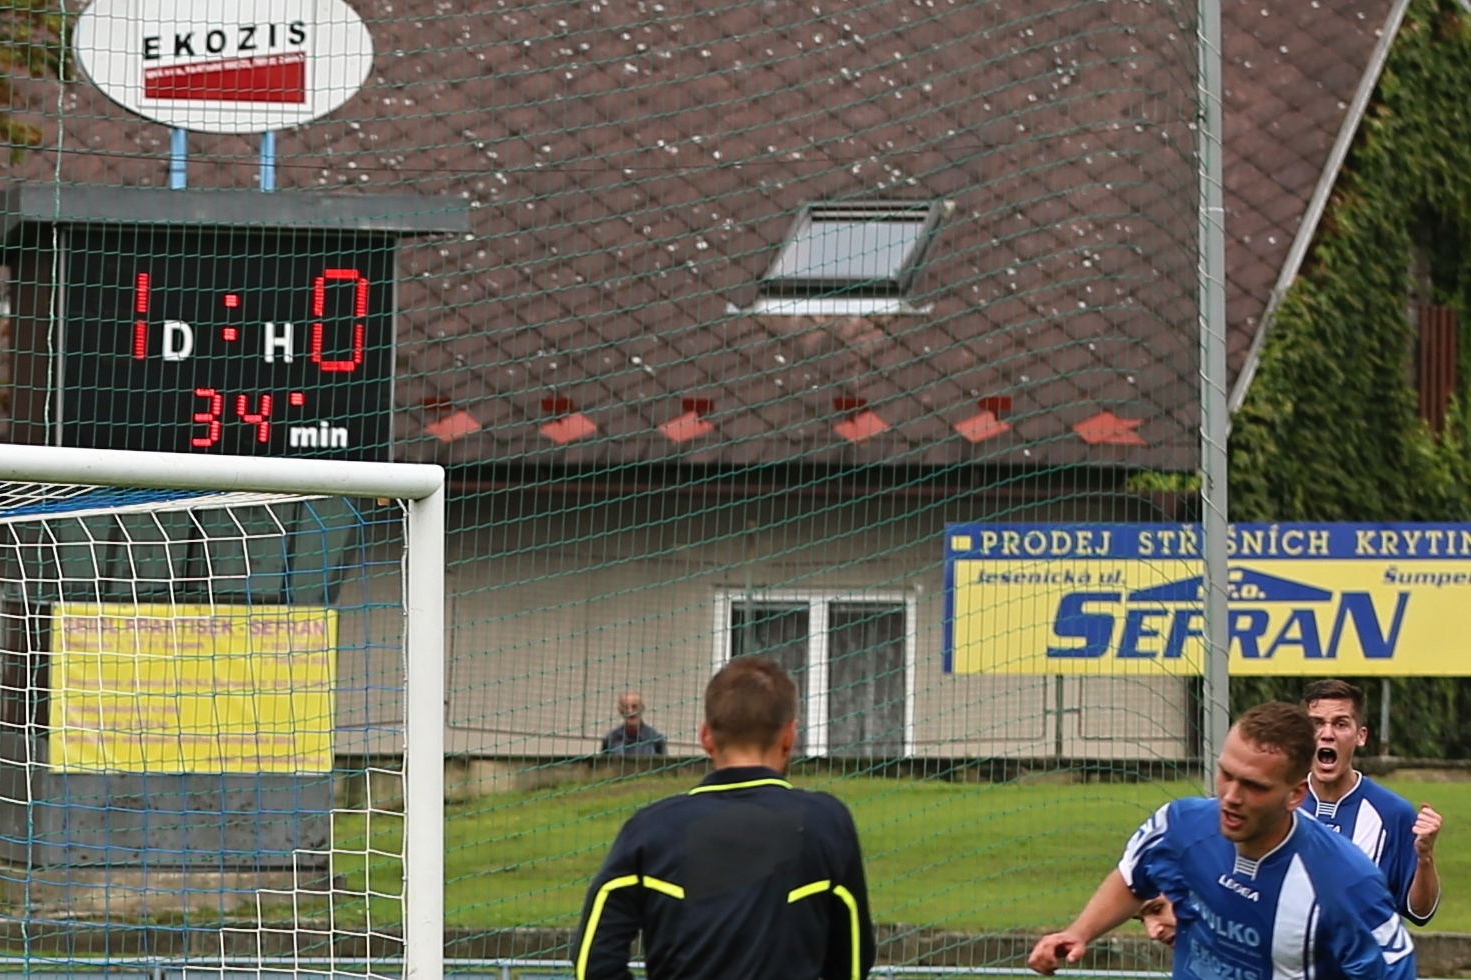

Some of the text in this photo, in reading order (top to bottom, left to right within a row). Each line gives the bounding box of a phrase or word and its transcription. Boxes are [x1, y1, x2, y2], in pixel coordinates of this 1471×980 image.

[144, 20, 306, 60] EKOZIS
[135, 273, 149, 359] 1
[313, 269, 369, 371] 0
[162, 320, 293, 363] D H
[290, 420, 349, 449] min
[980, 530, 1113, 556] PRODEJ
[1138, 523, 1330, 556] STŘŠNÍCH
[1100, 569, 1127, 585] ul.
[1383, 565, 1471, 588] Šumpe
